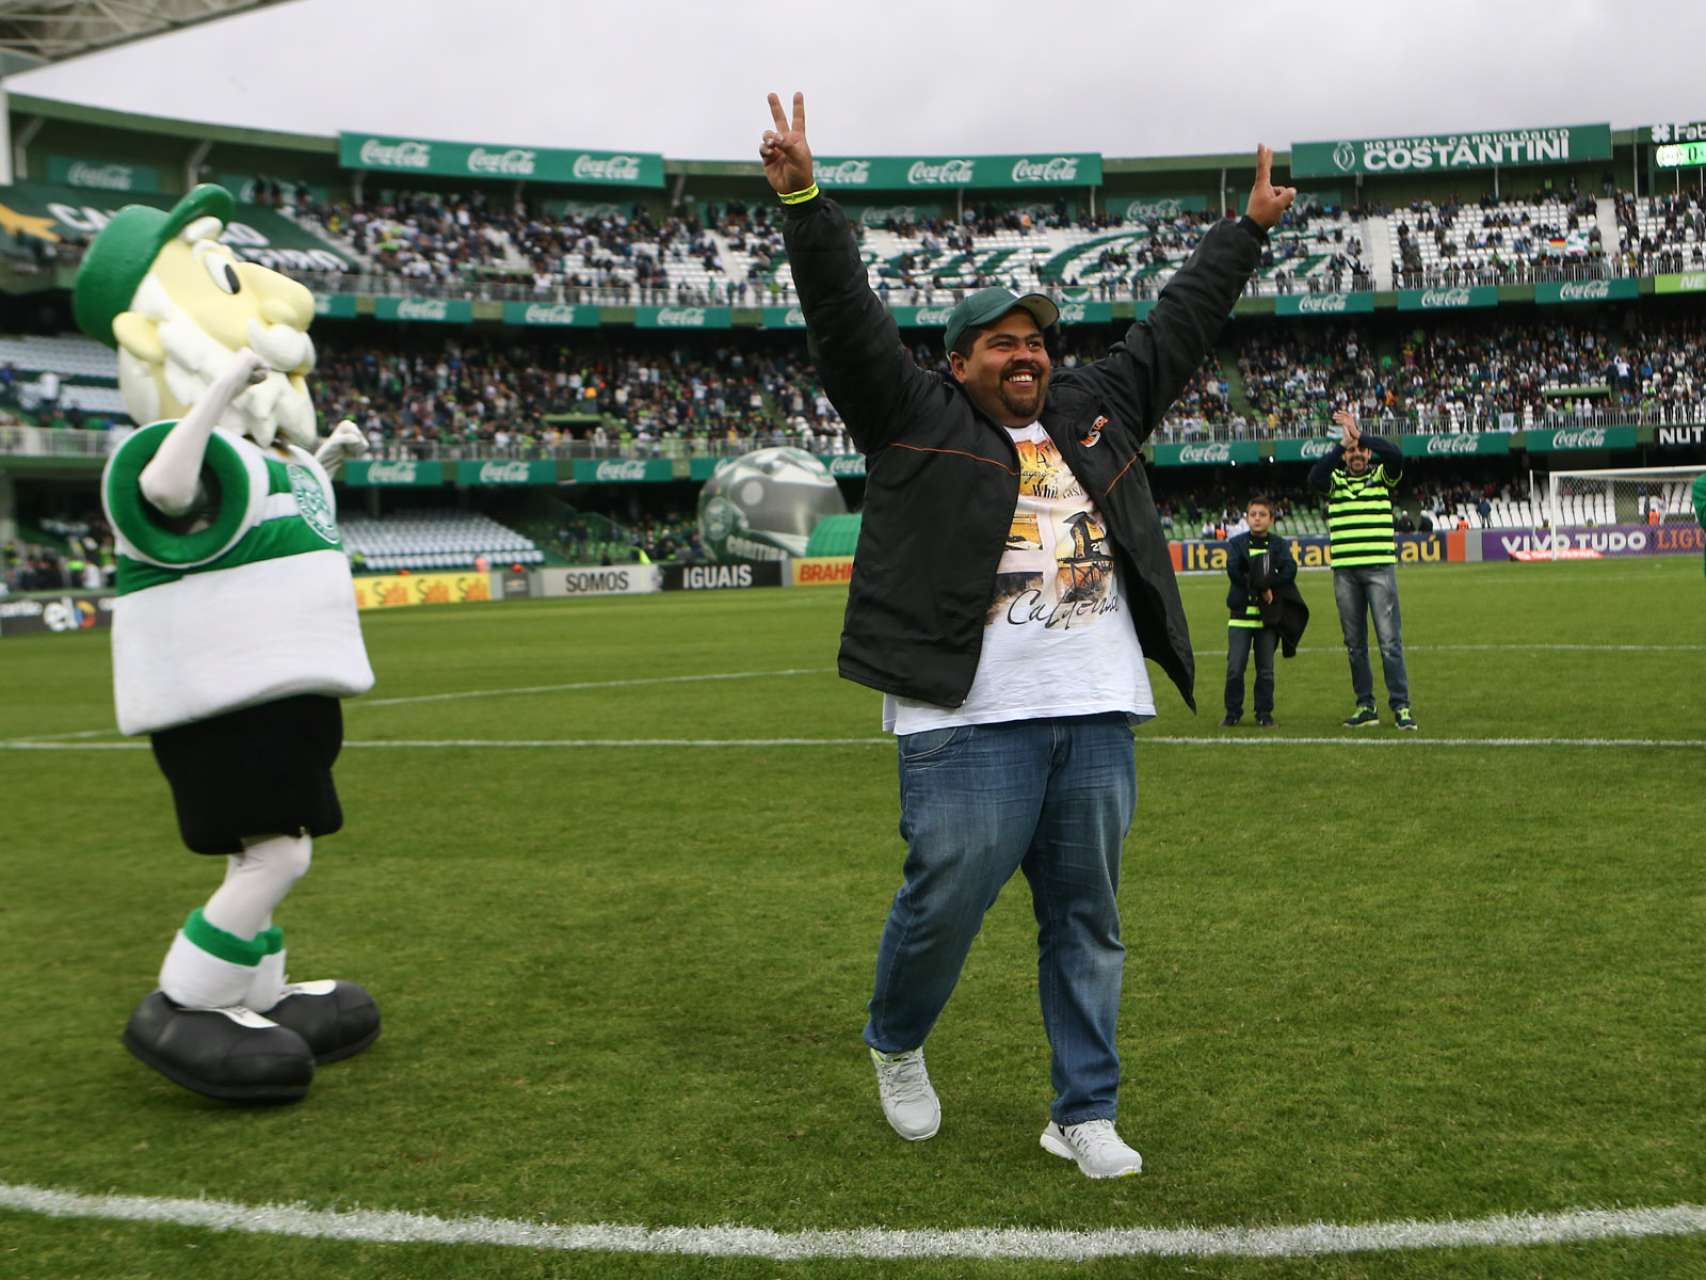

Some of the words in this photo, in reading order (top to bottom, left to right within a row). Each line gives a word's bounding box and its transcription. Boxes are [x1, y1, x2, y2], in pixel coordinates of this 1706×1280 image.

[1363, 137, 1570, 170] COSTANTINI
[1364, 138, 1438, 150] HOSPITAL
[1659, 426, 1704, 445] NUT
[1501, 533, 1571, 553] VIVO
[1575, 531, 1646, 551] TUDO
[1187, 543, 1228, 569] Ita
[565, 571, 629, 593] SOMOS
[683, 564, 752, 589] IGUAIS
